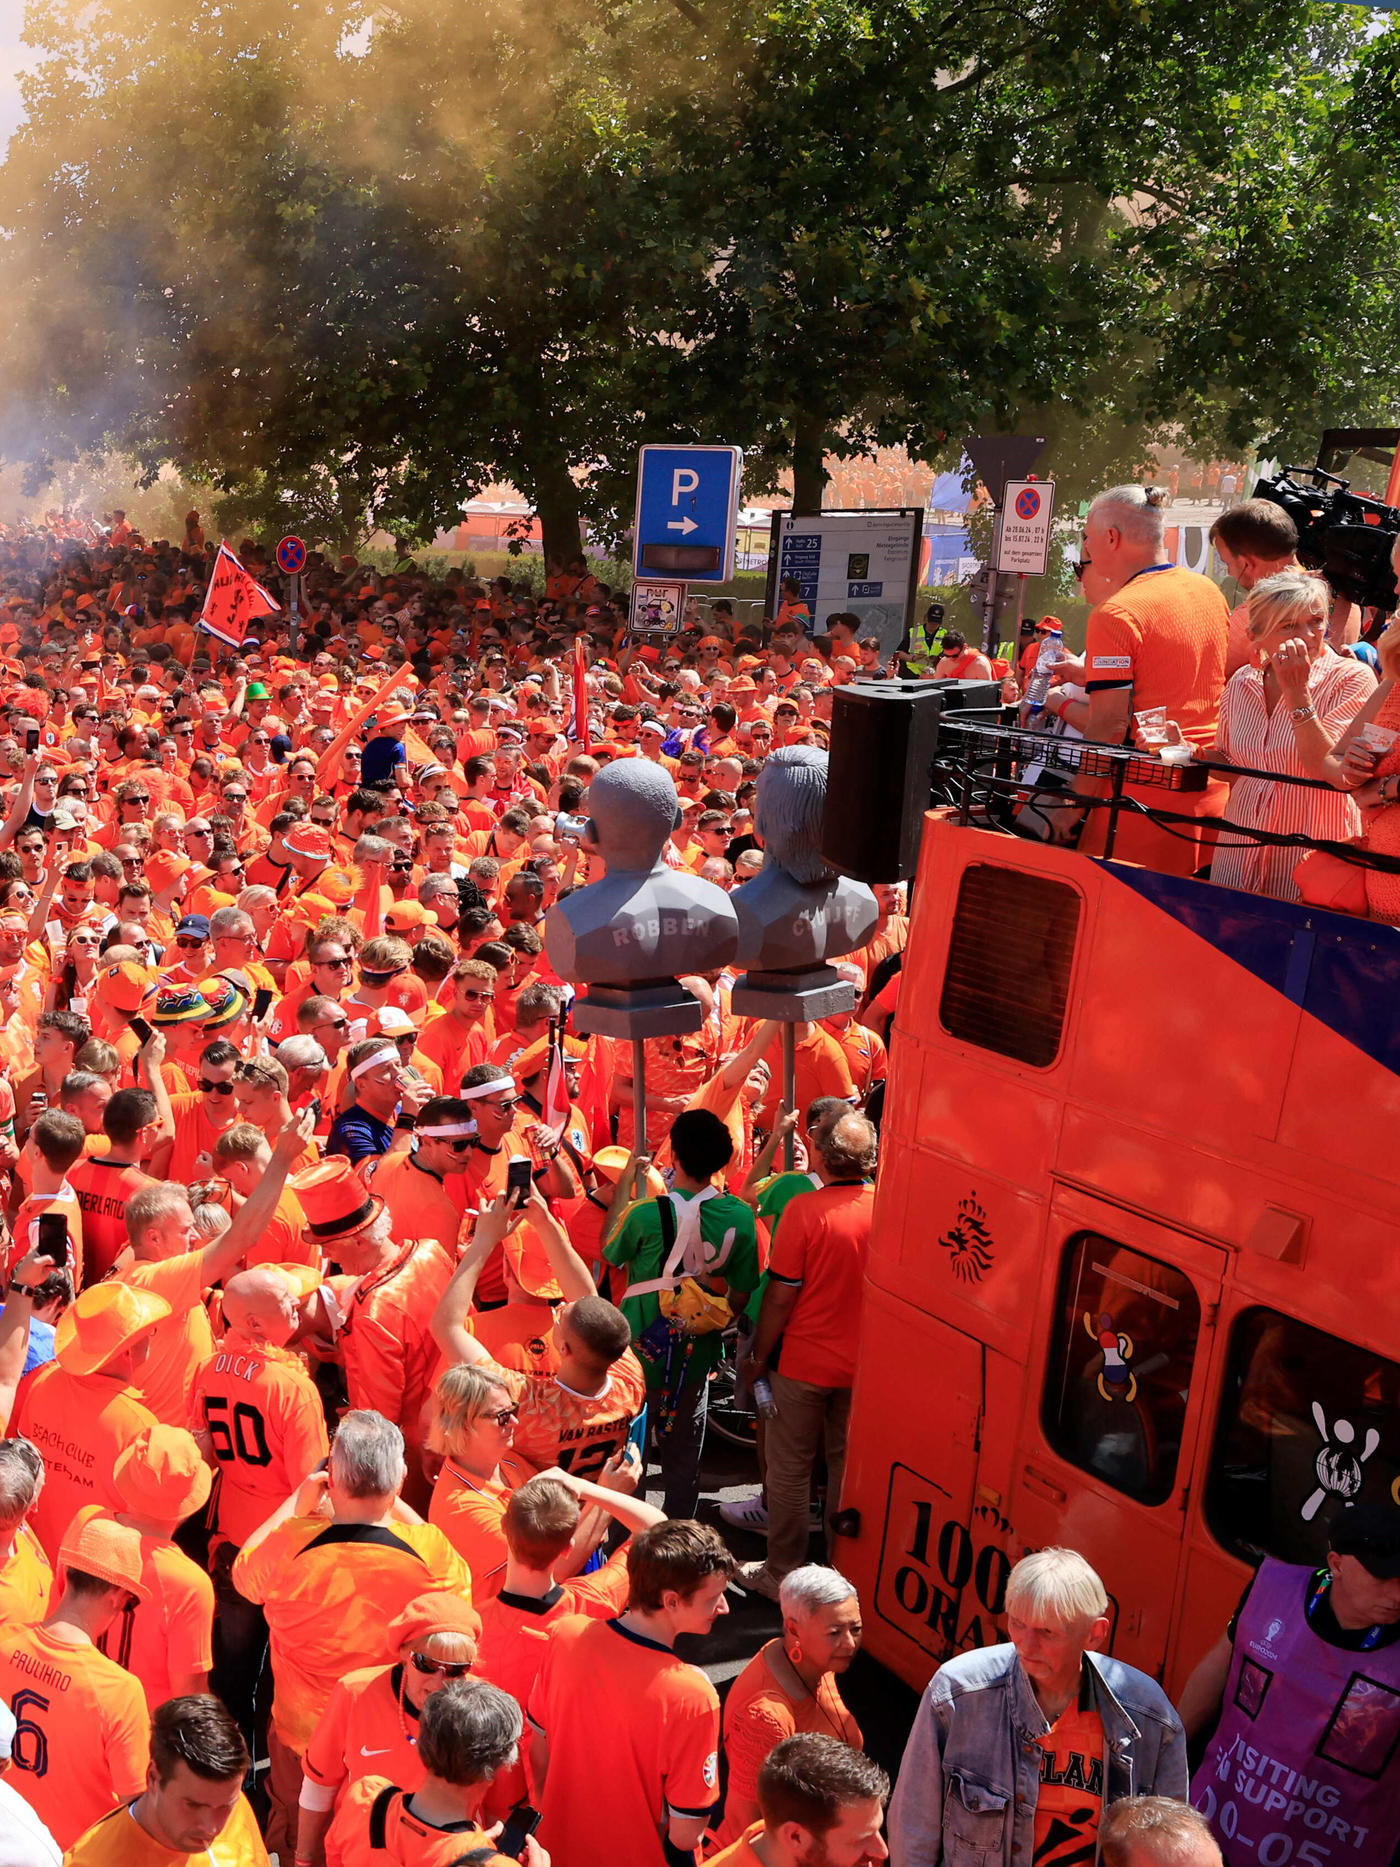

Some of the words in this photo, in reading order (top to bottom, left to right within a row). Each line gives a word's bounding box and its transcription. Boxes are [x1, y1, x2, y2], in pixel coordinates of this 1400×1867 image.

[672, 468, 699, 506] P
[806, 538, 818, 548] 25
[804, 586, 810, 597] 7
[612, 917, 712, 947] ROBBEN
[77, 1190, 125, 1220] DERLAND
[215, 1353, 260, 1382] DICK
[558, 1427, 584, 1443] VAN
[894, 1566, 1011, 1651] ORA
[11, 1688, 50, 1779] 6
[1234, 1769, 1369, 1849] SUPPORT
